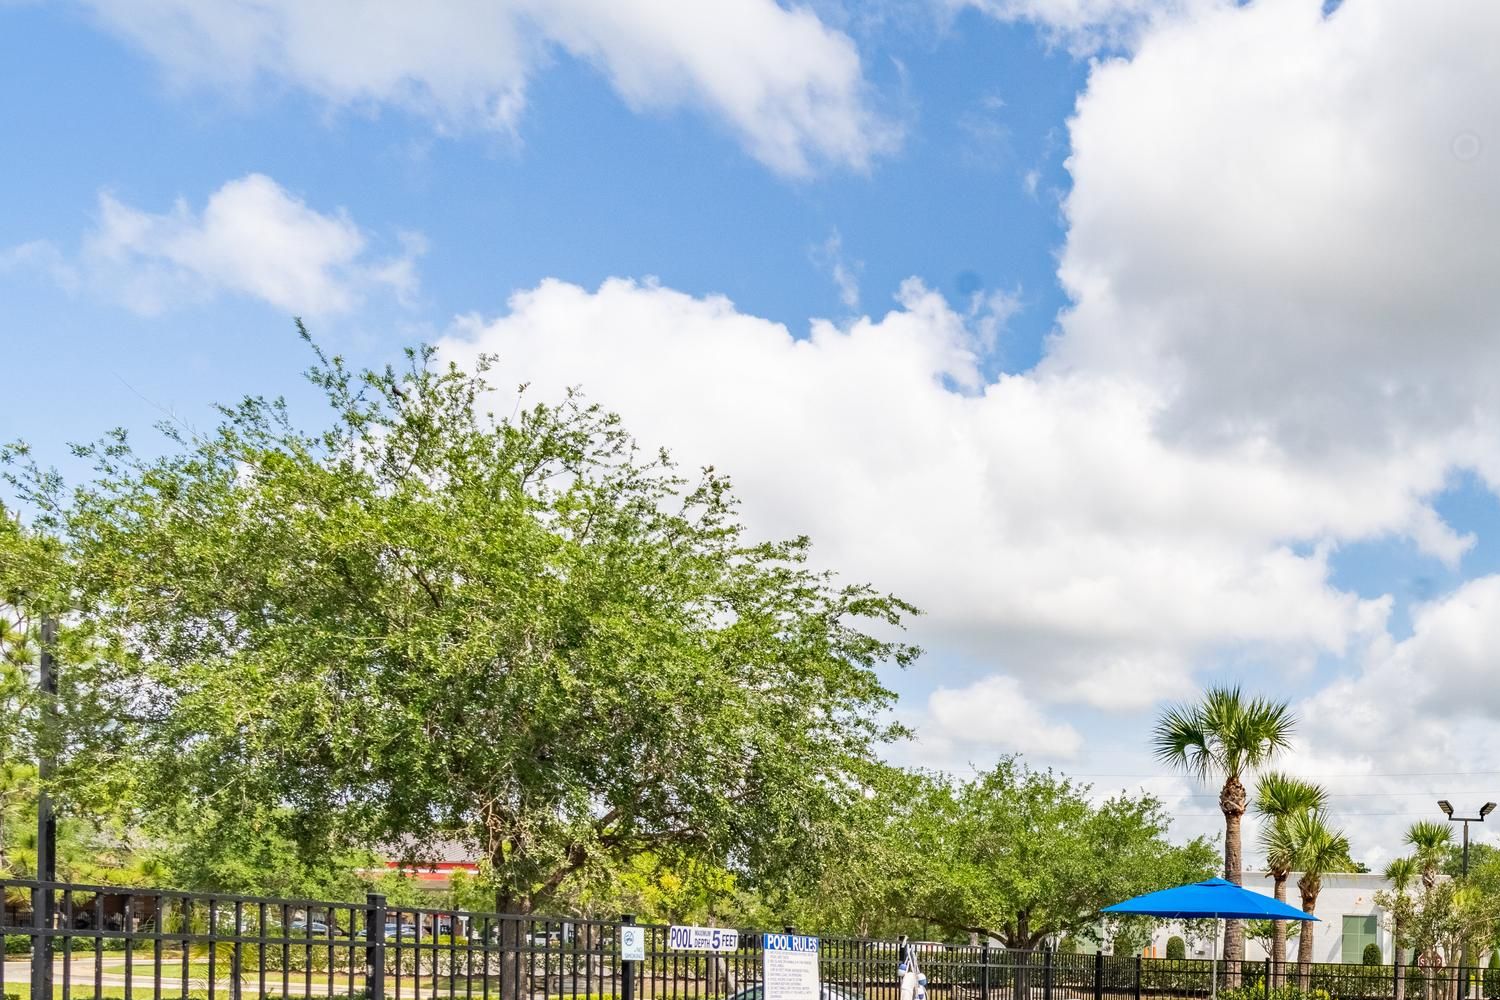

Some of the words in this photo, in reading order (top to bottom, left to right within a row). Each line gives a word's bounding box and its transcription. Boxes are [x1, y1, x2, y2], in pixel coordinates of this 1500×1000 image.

[671, 927, 692, 948] POOL
[712, 930, 721, 949] 5
[722, 934, 737, 947] FEET
[694, 938, 711, 948] DEPTH
[768, 934, 792, 950] POOL
[793, 936, 817, 952] RULES
